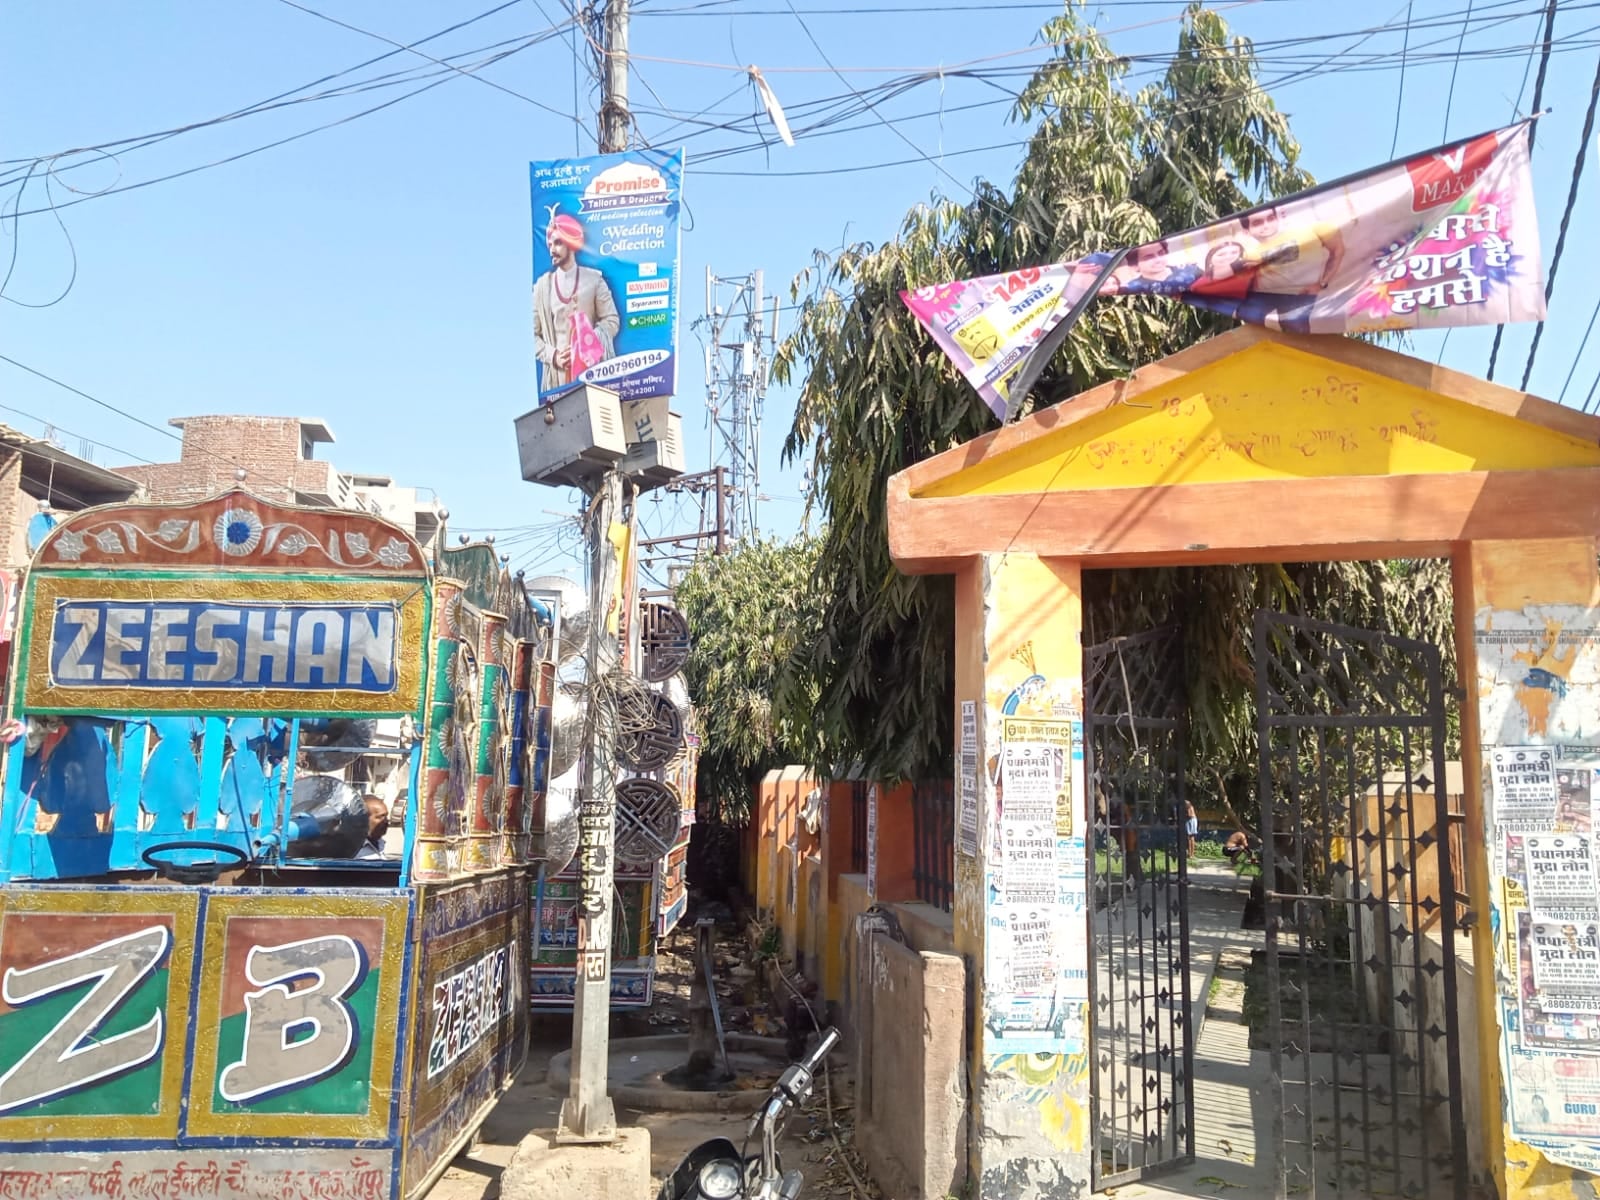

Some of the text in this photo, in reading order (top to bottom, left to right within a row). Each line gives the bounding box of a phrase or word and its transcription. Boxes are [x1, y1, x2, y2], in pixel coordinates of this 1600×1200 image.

[1432, 144, 1467, 174] V
[595, 177, 660, 193] Promise
[588, 197, 618, 209] Tailors
[602, 223, 665, 240] Wedding
[600, 237, 665, 256] Collection
[1482, 233, 1513, 267] है
[1388, 269, 1488, 314] हमसे
[637, 313, 666, 326] CHINAR
[595, 352, 663, 378] 7007960194
[57, 607, 394, 685] ZEESHAN
[1028, 767, 1048, 777] लोन
[1523, 772, 1550, 784] लोन
[1504, 823, 1555, 832] 880820783
[1031, 849, 1052, 859] लोन
[1561, 860, 1589, 871] लोन
[0, 925, 362, 1111] Z B
[1564, 1103, 1597, 1115] GURU
